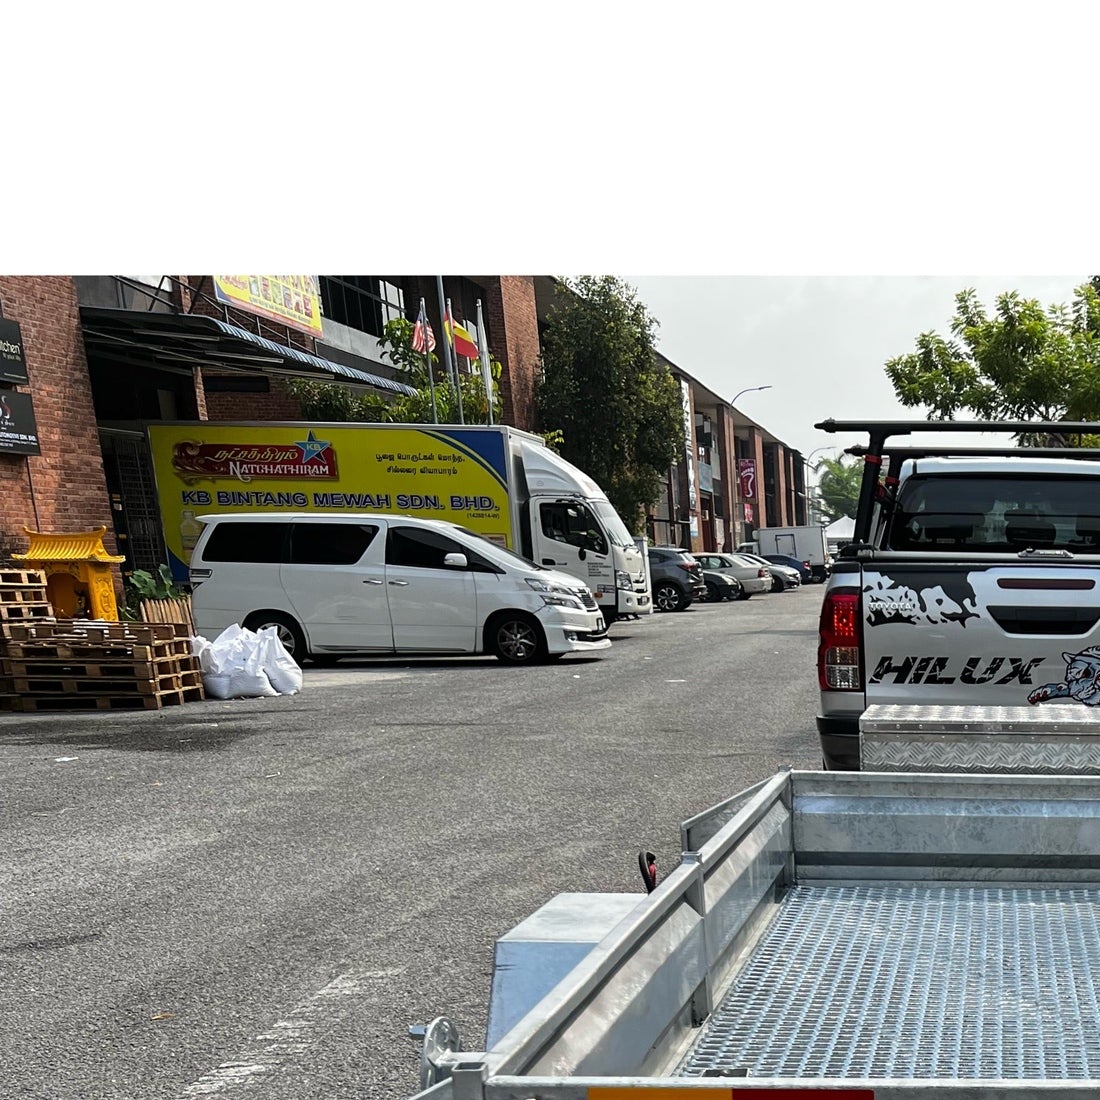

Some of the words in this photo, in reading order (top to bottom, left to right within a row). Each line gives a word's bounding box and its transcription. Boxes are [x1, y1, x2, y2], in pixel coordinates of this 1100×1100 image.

[306, 443, 321, 451] KB
[229, 461, 329, 482] NATCHATHIRAM
[182, 490, 212, 505] KB
[217, 491, 308, 506] BINTANG
[313, 493, 391, 508] MEWAH
[396, 494, 445, 509] SDN.
[450, 495, 501, 511] BHD.
[869, 602, 914, 610] TOYOTA
[868, 655, 1047, 685] HILUX
